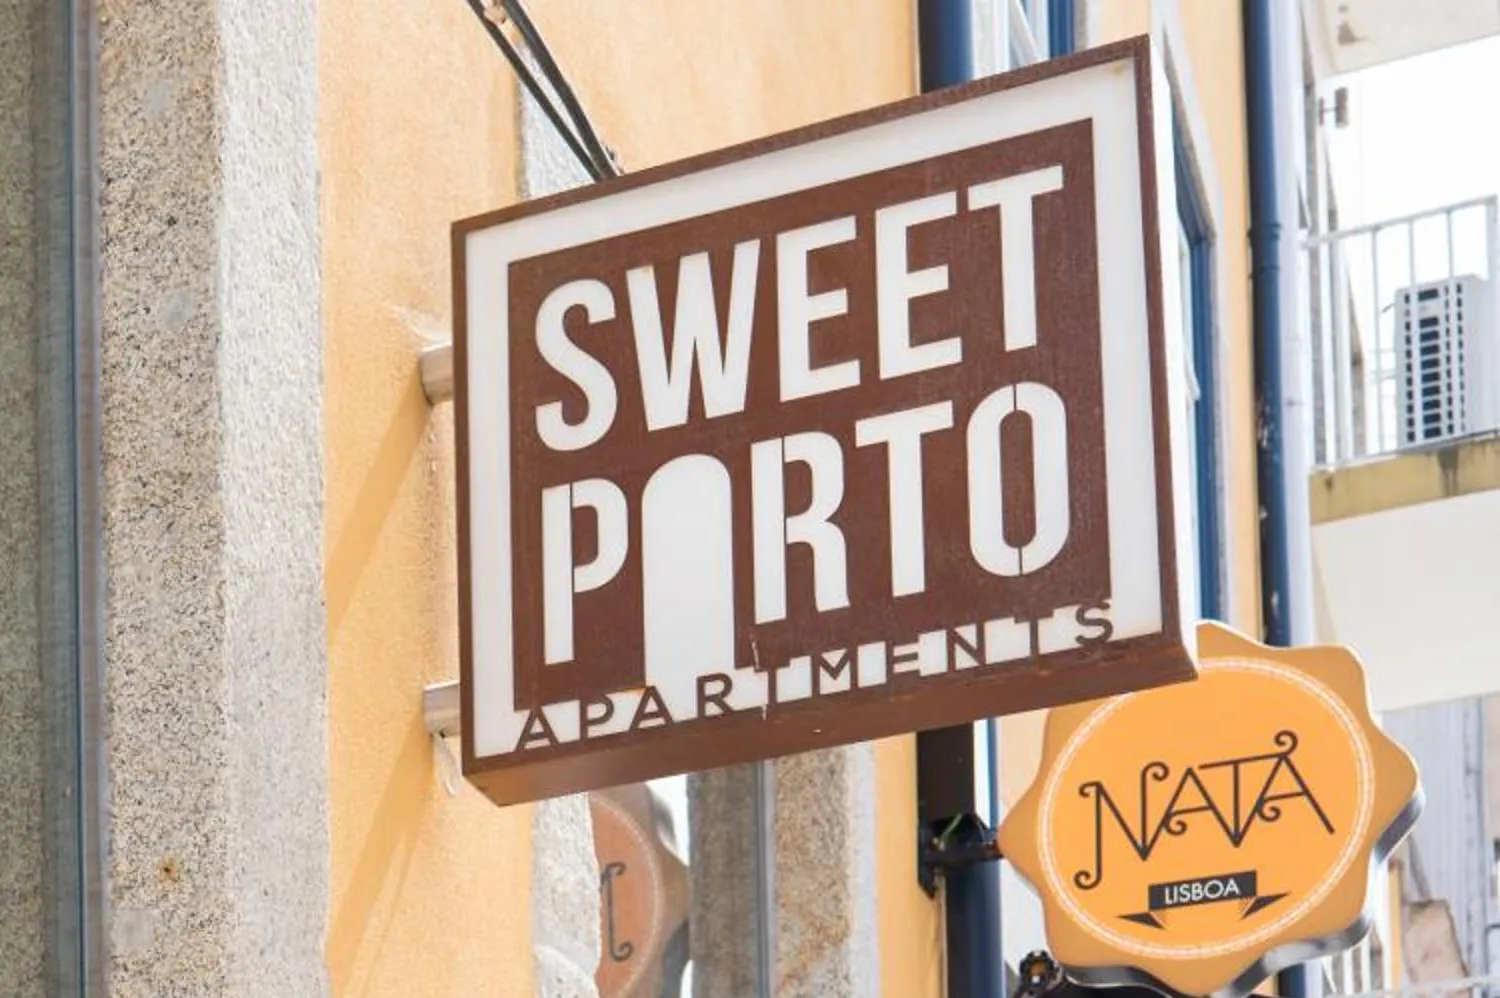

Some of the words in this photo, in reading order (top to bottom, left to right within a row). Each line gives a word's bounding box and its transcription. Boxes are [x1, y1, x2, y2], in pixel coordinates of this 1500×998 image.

[534, 165, 1065, 453] SWEET
[541, 381, 1070, 682] PORTO
[514, 599, 1114, 753] APARTMENTS
[1074, 730, 1336, 890] NATA
[1164, 876, 1241, 905] LISBOA
